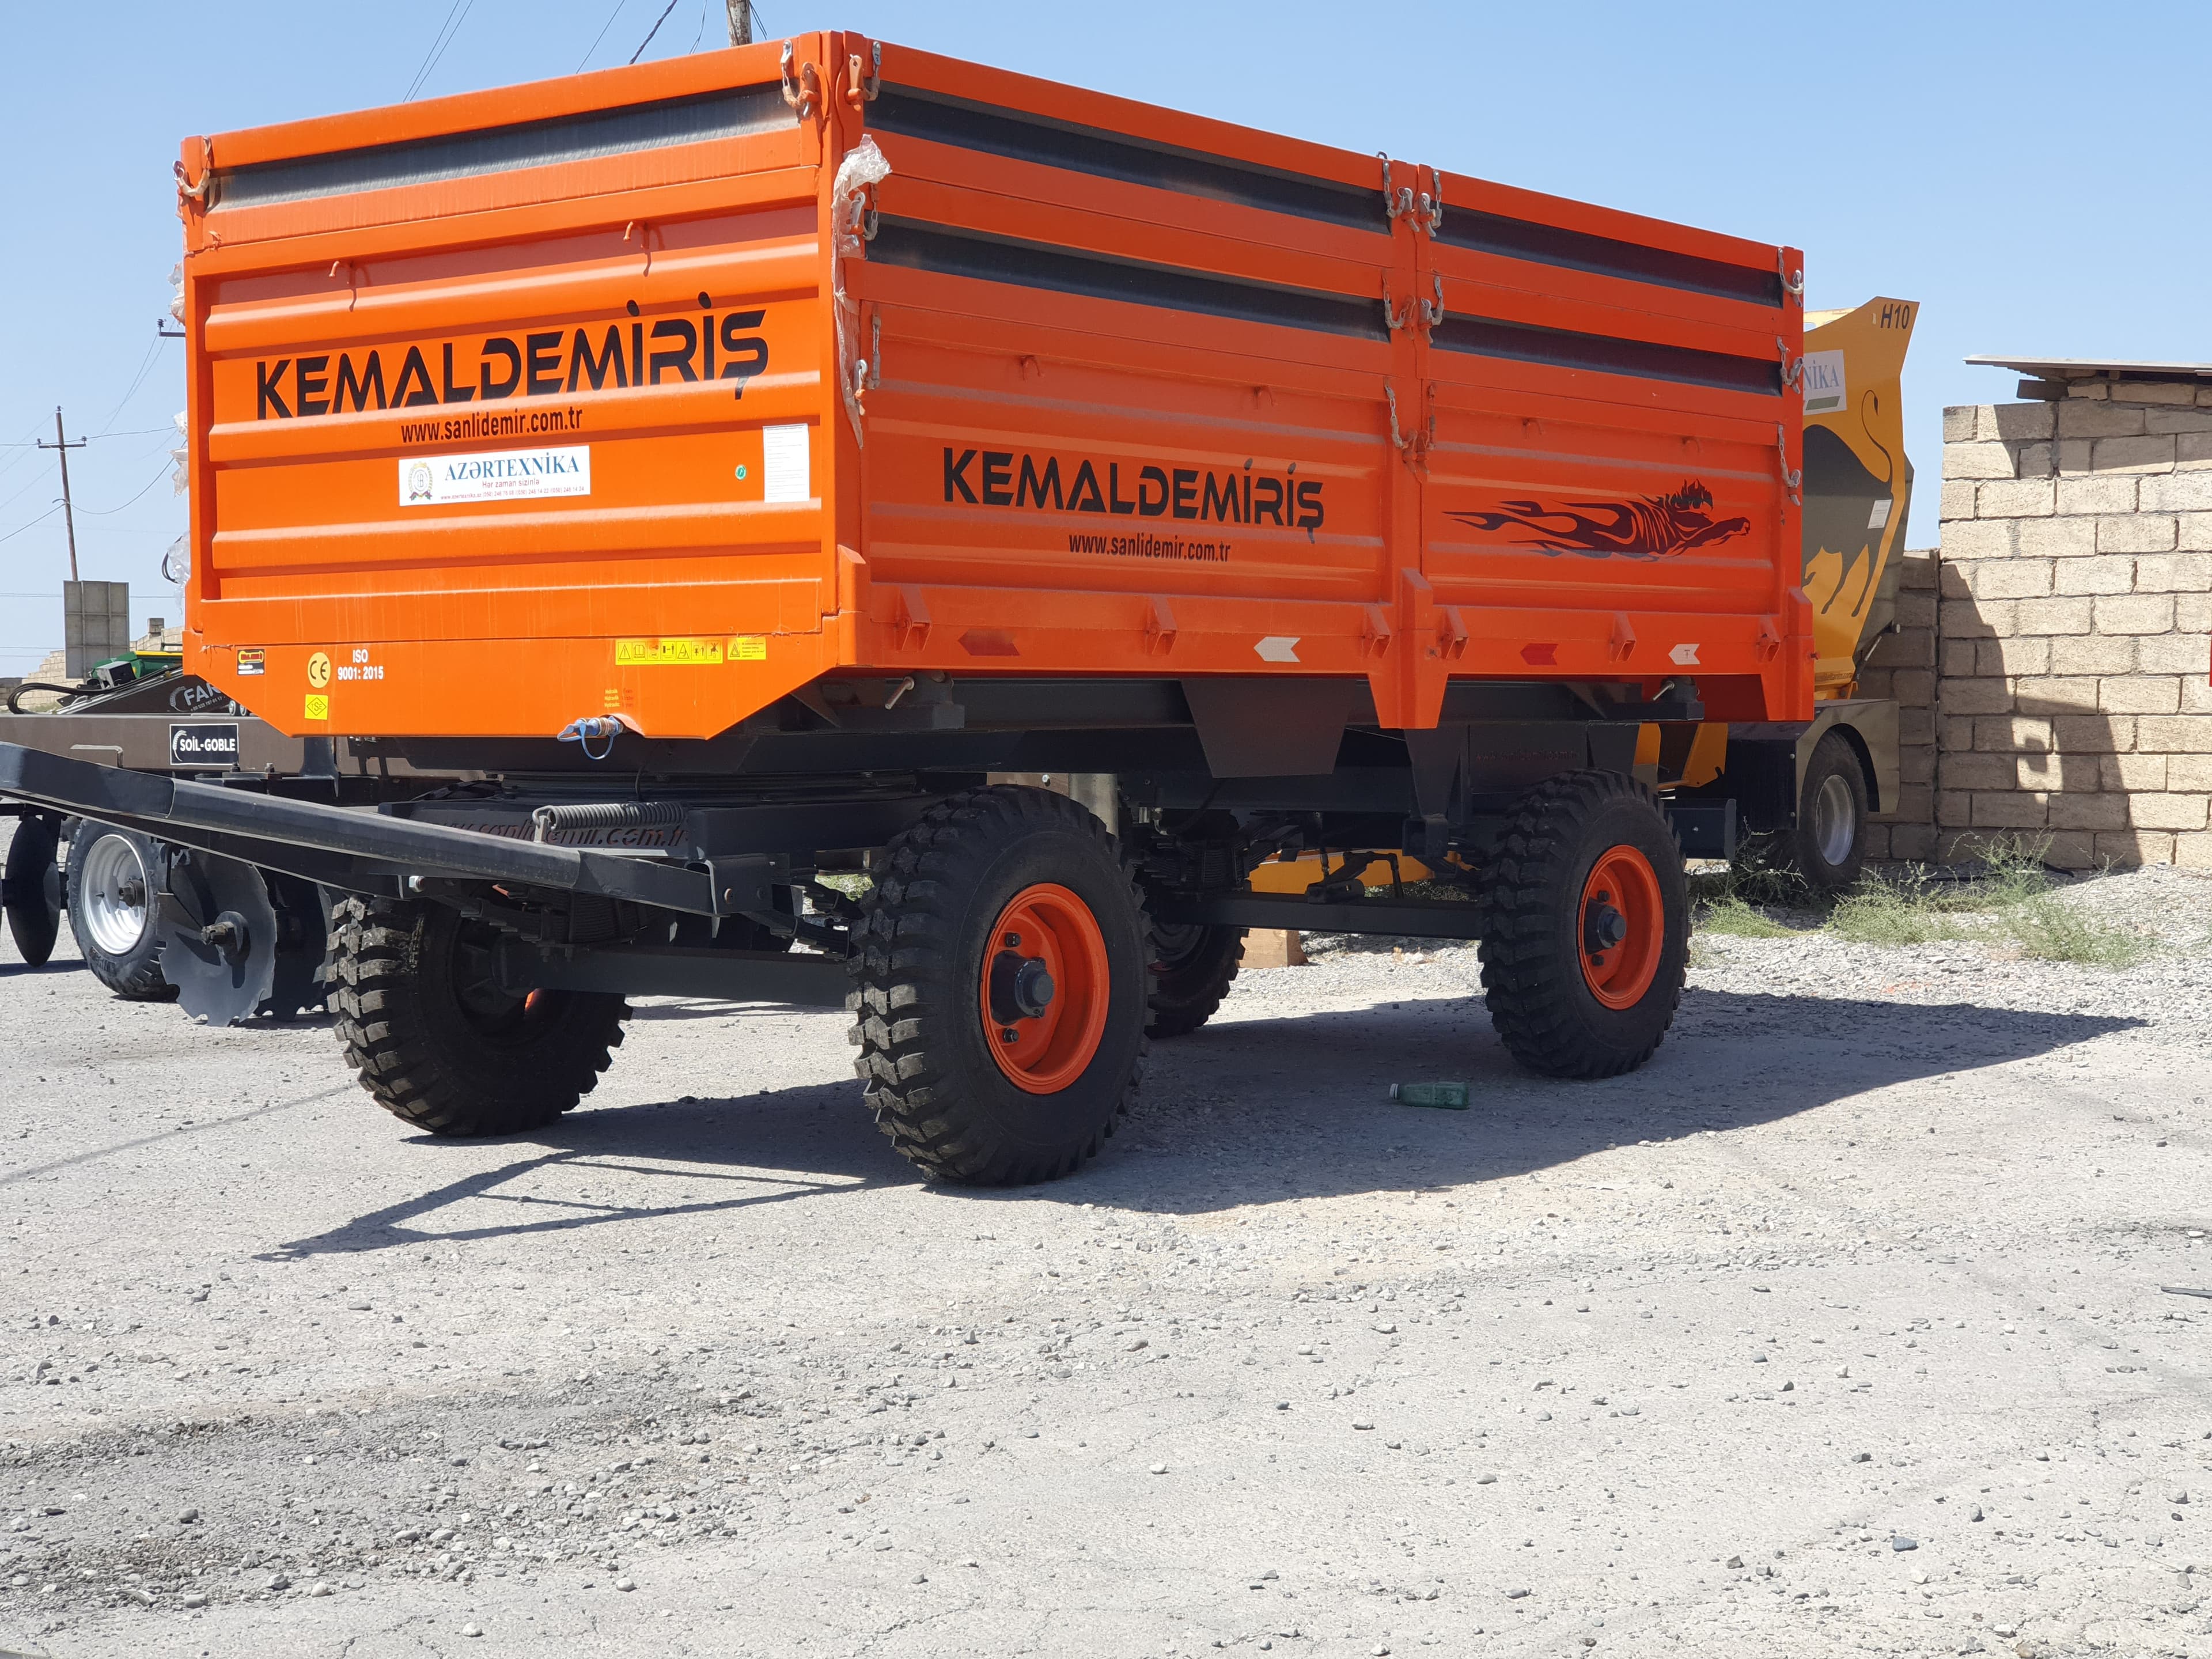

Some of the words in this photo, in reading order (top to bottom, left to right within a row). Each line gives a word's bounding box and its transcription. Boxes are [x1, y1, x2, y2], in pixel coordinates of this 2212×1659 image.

[1880, 304, 1910, 329] H10
[257, 291, 768, 420] KEMALDEMİRİŞ
[402, 407, 582, 443] www.sanlidemir.com.tr
[445, 452, 579, 480] AZƏRTEXNİKA
[482, 480, 493, 488] Hər
[495, 480, 516, 488] zaman
[943, 447, 1324, 544] KEMALDEMİRİŞ
[1068, 532, 1232, 563] www.sanlidemir.com.tr
[353, 649, 368, 662] ISO
[309, 660, 327, 680] CE
[338, 666, 361, 680] 9001:
[363, 666, 384, 680] 2015
[311, 702, 323, 711] TSE
